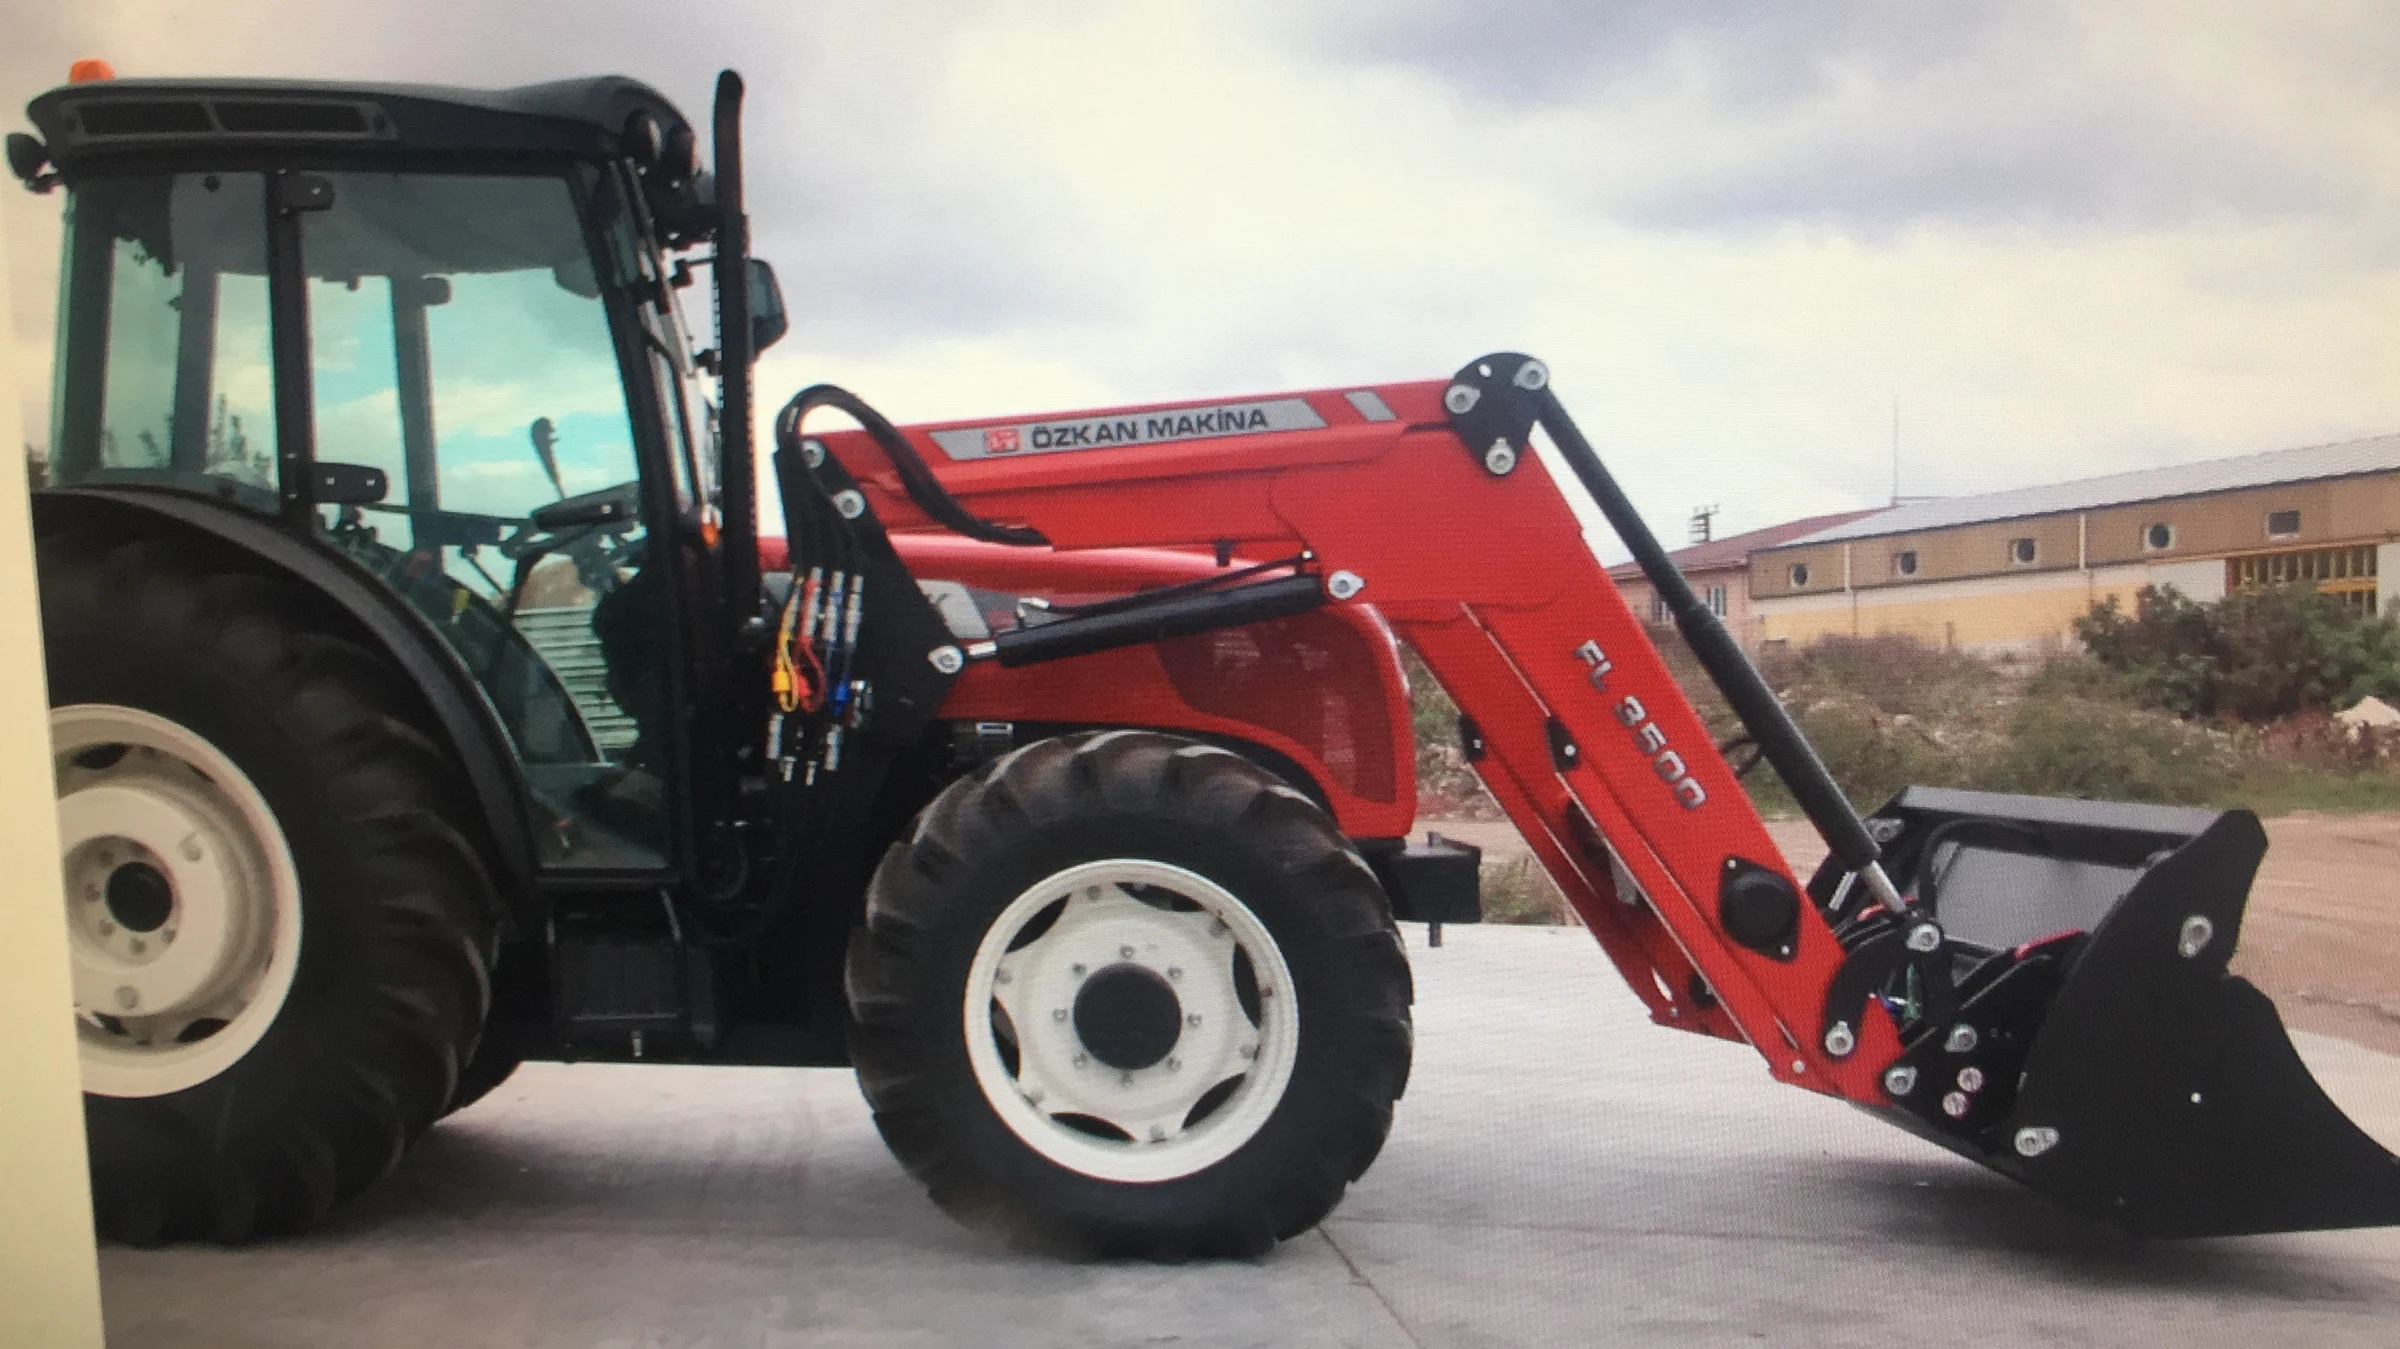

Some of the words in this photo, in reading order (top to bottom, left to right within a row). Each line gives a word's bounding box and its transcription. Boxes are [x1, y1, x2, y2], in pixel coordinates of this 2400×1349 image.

[1031, 421, 1137, 448] ÖZKAN
[1147, 408, 1269, 439] MAKİNA
[1574, 639, 1613, 692] FL
[1613, 695, 1708, 810] 3500
